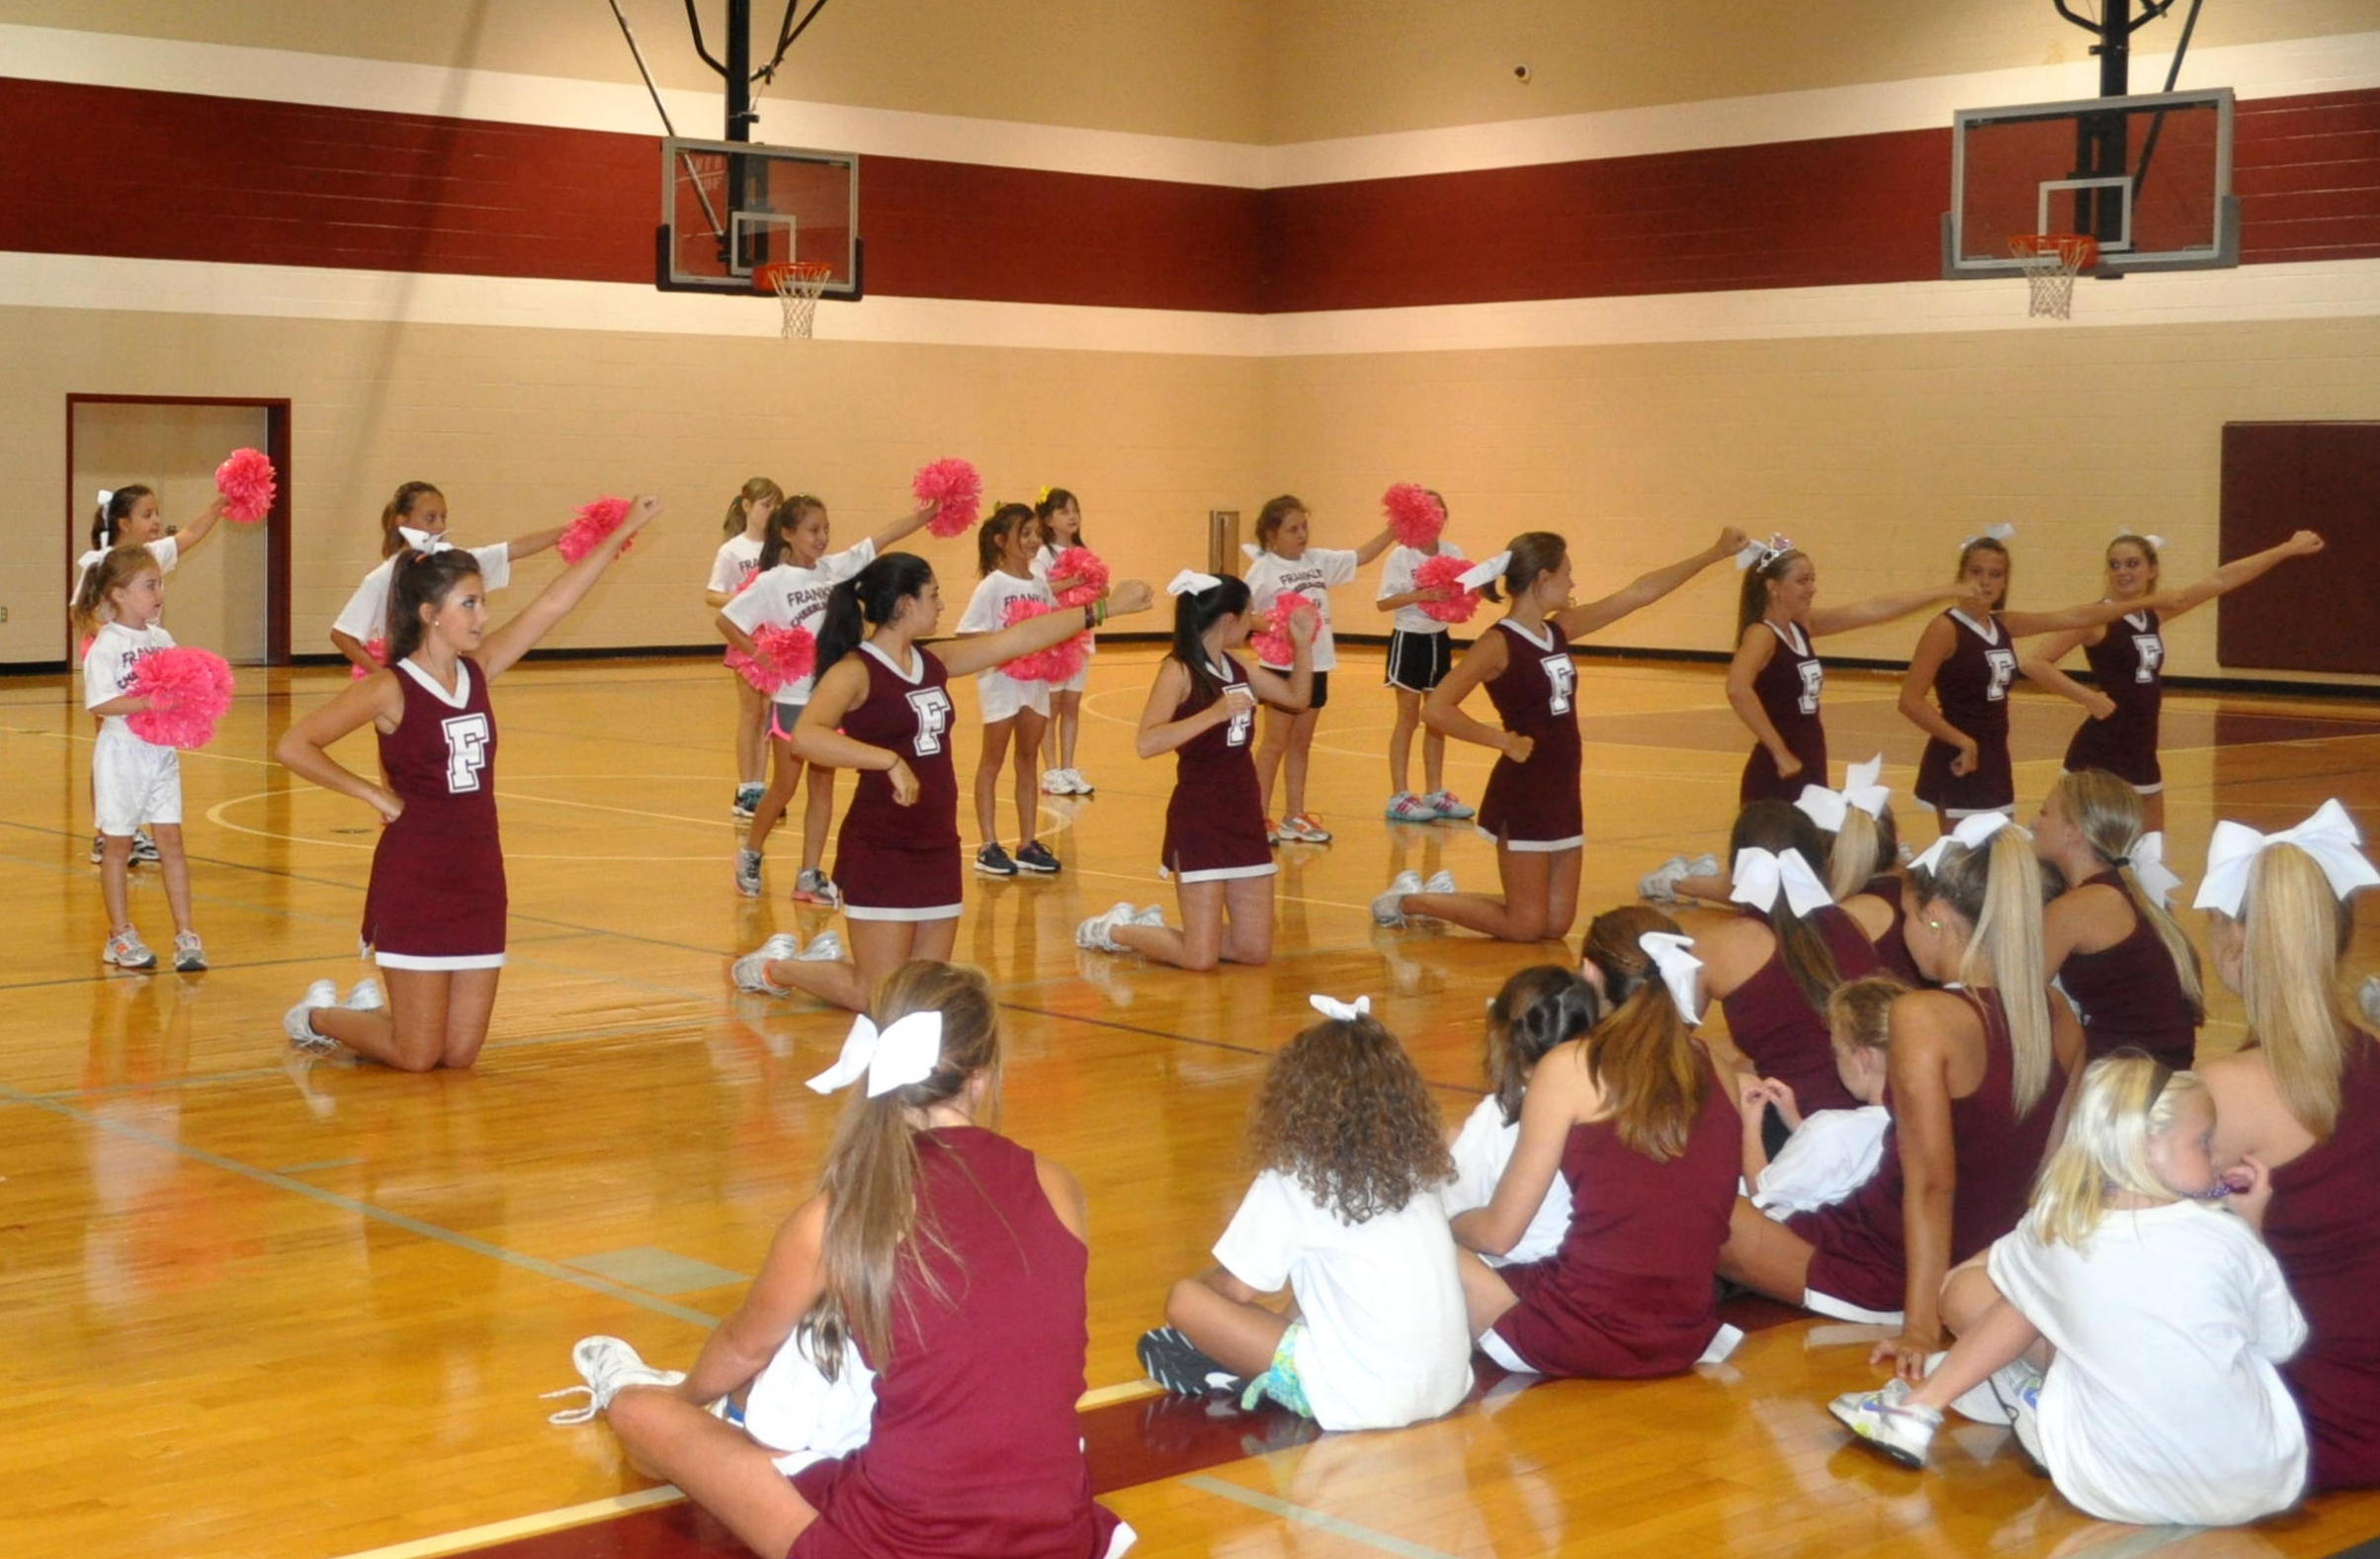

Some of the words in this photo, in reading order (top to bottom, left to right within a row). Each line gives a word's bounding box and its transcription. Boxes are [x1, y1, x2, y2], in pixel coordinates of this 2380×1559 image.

[1540, 652, 1575, 716] F
[1797, 659, 1824, 714] F
[1985, 649, 2016, 701] F
[2131, 634, 2163, 683] F
[905, 686, 951, 756] F
[441, 712, 489, 794] F
